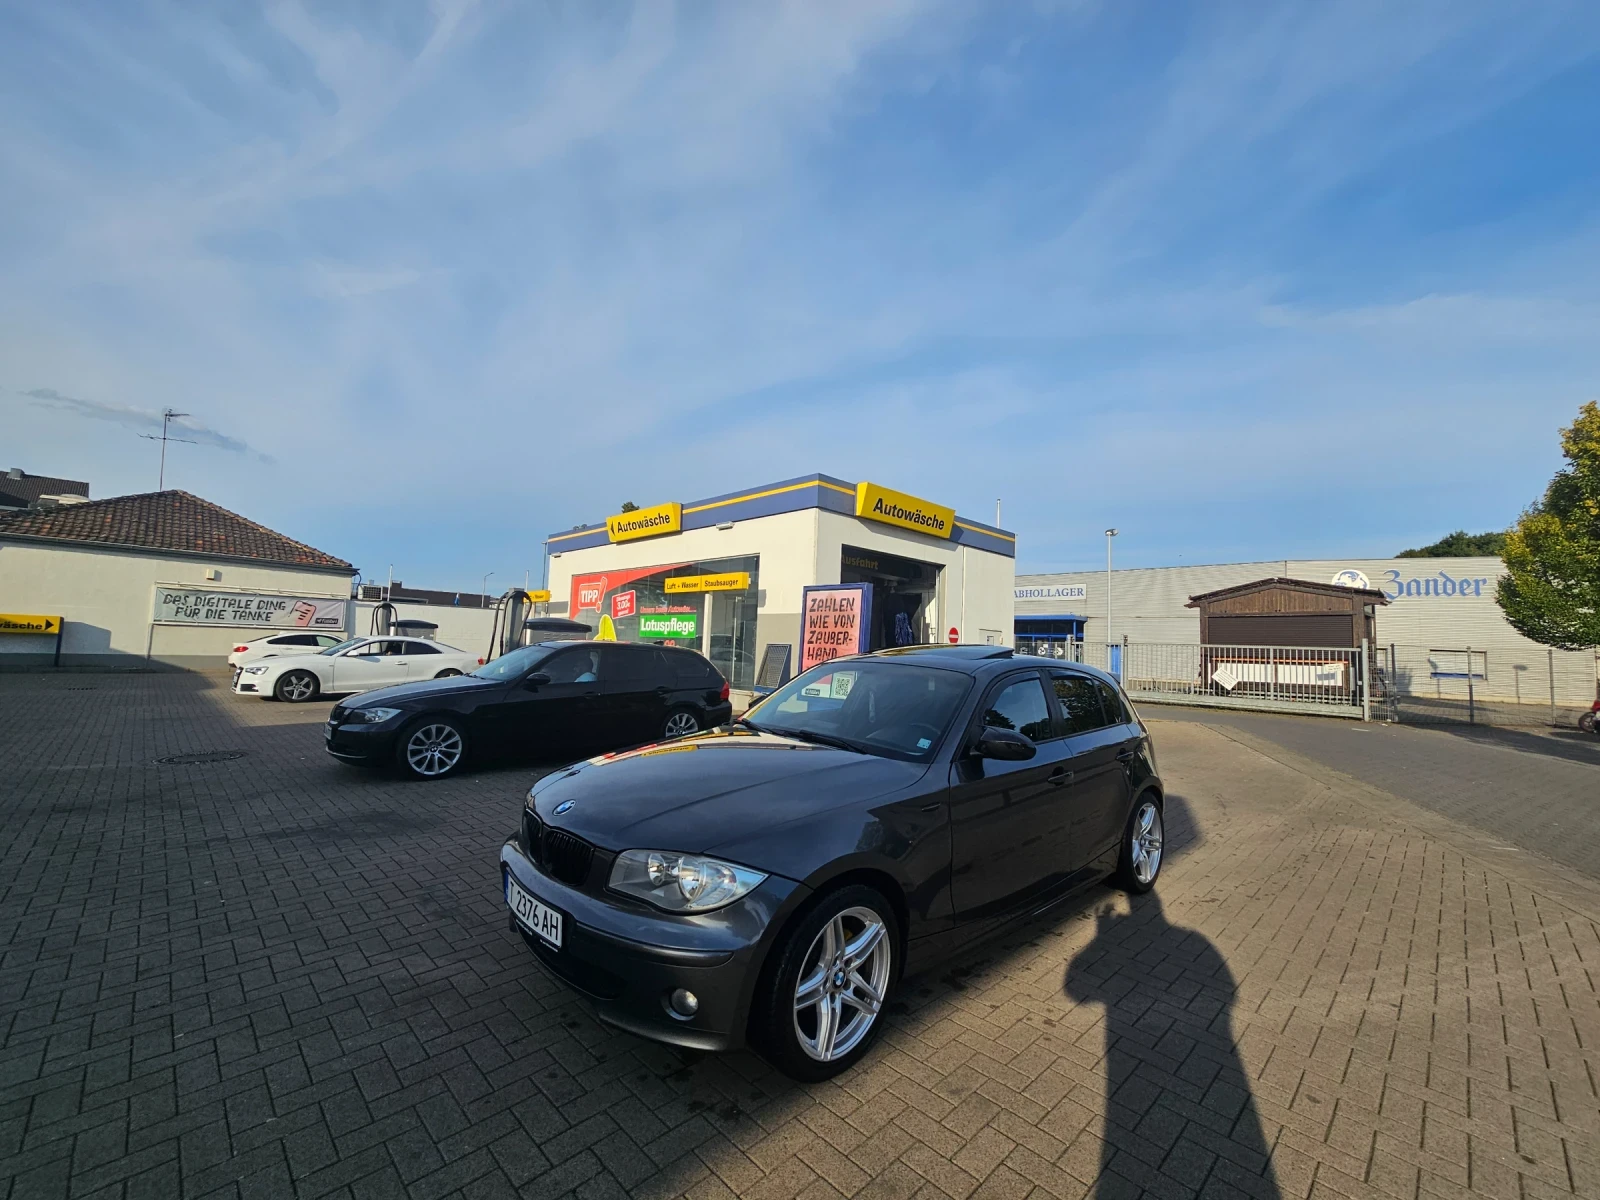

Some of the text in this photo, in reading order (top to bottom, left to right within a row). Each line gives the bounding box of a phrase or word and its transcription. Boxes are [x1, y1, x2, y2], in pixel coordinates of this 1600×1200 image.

[617, 513, 670, 533] Autowäsche
[873, 498, 944, 530] Autowäsche
[704, 579, 738, 587] Staubsauger
[1382, 569, 1487, 600] Zander
[163, 593, 286, 611] DAS DIGITALE DING
[809, 597, 855, 612] ZAHLEN
[175, 606, 274, 622] FÜR DIE TANKE
[809, 614, 855, 628] WIE VON
[640, 617, 695, 635] Lotuspflege
[807, 630, 853, 645] ZAUBER-
[510, 881, 558, 940] T 2376 AH
